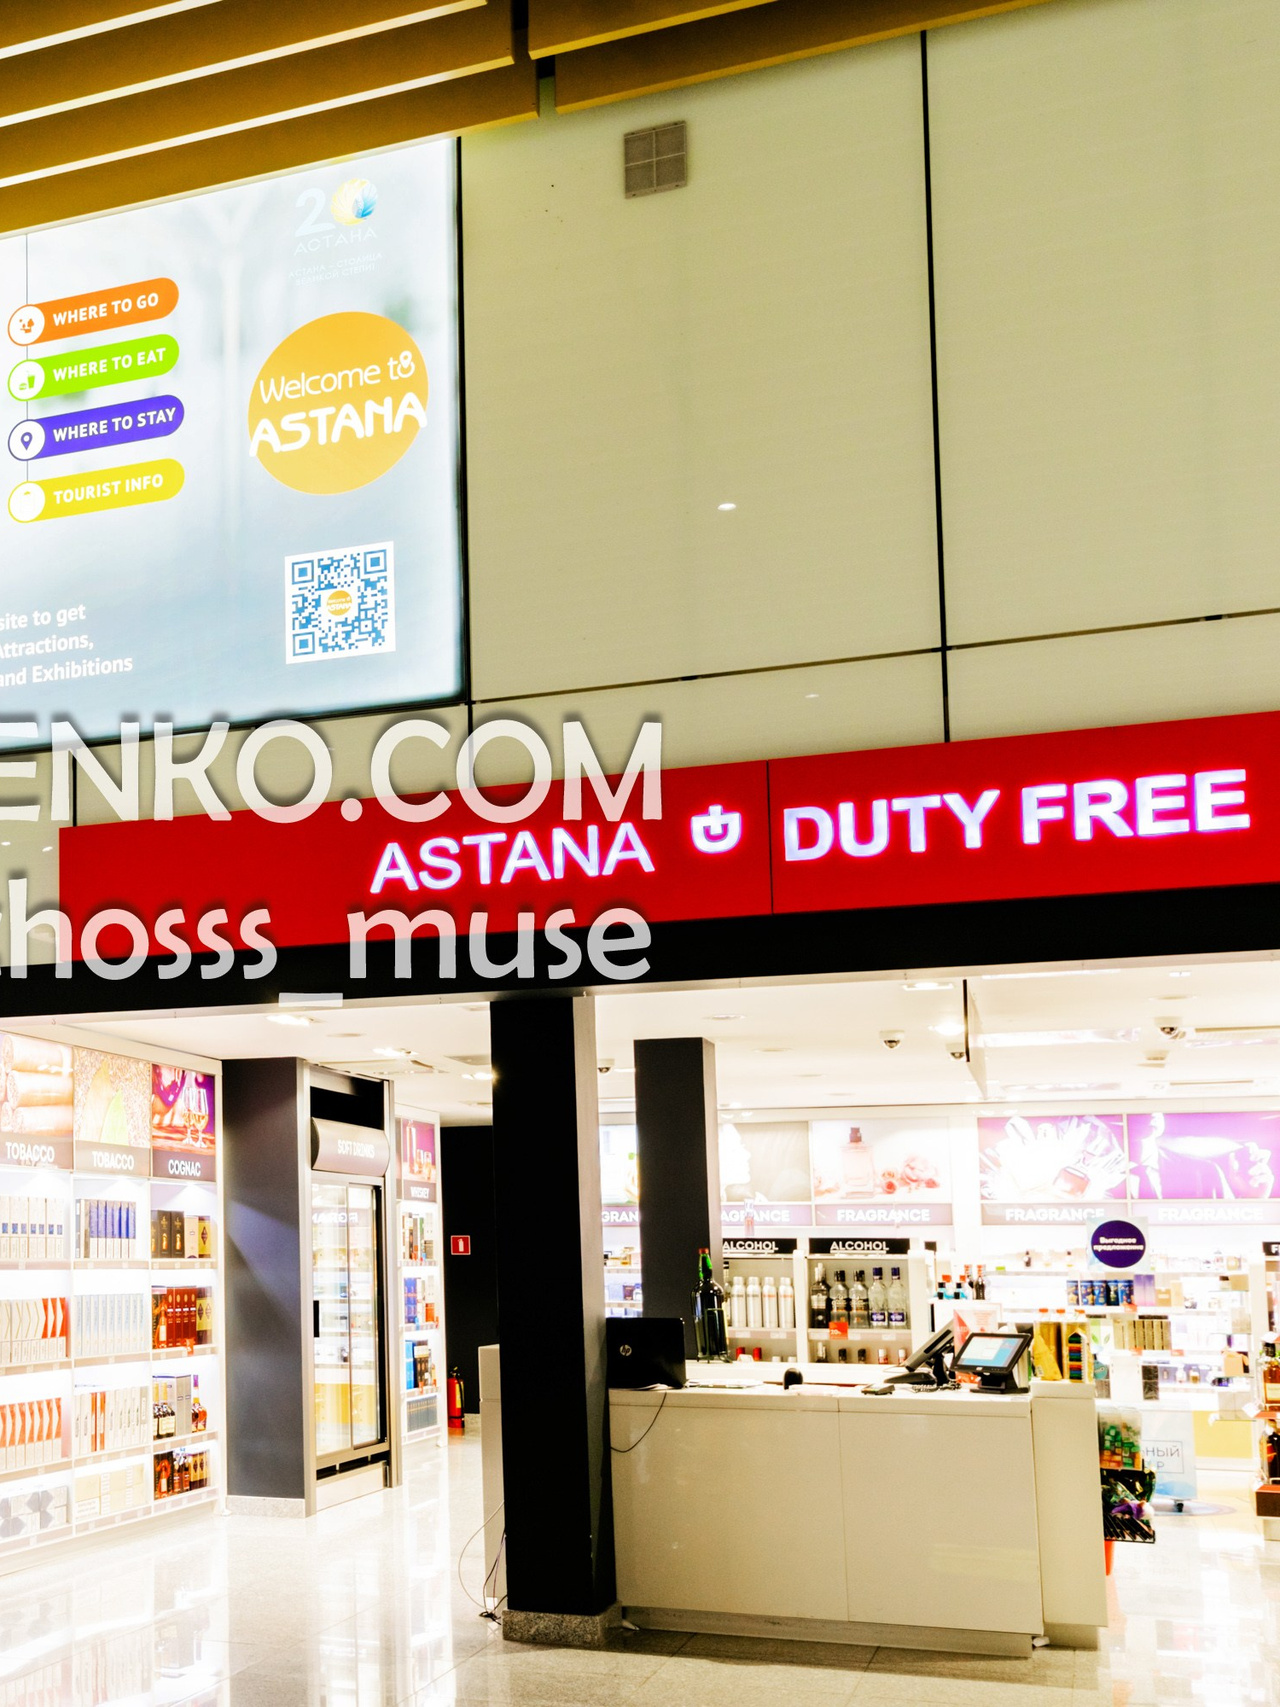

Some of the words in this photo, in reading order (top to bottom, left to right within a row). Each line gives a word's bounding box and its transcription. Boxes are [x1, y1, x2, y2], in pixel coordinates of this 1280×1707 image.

[52, 304, 107, 327] WHERE
[111, 298, 132, 315] TO
[137, 293, 159, 310] GO
[52, 358, 107, 382] WHERE
[111, 353, 133, 370] TO
[137, 347, 166, 365] EAT
[259, 364, 381, 404] Welcome
[52, 418, 107, 442] WHERE
[111, 413, 133, 431] TO
[137, 406, 176, 427] STAY
[248, 391, 428, 457] ASTANA
[53, 480, 121, 504] TOURIST
[124, 473, 164, 494] INFO
[32, 608, 51, 626] to
[56, 604, 86, 629] get
[32, 655, 133, 683] Exhibitions
[370, 822, 655, 894] ASTANA
[783, 789, 1000, 861] DUTY
[1021, 768, 1251, 845] FREE
[5, 1141, 55, 1162] TOBACCO
[92, 1151, 134, 1170] TOBACCO
[168, 1159, 201, 1177] COGNAC
[836, 1208, 931, 1222] FRAGRANCE
[1005, 1207, 1105, 1221] FRAGRANCE
[1158, 1207, 1264, 1221] FRAGRANCE
[722, 1240, 778, 1251] ALCOHOL
[830, 1240, 889, 1251] ALCOHOL
